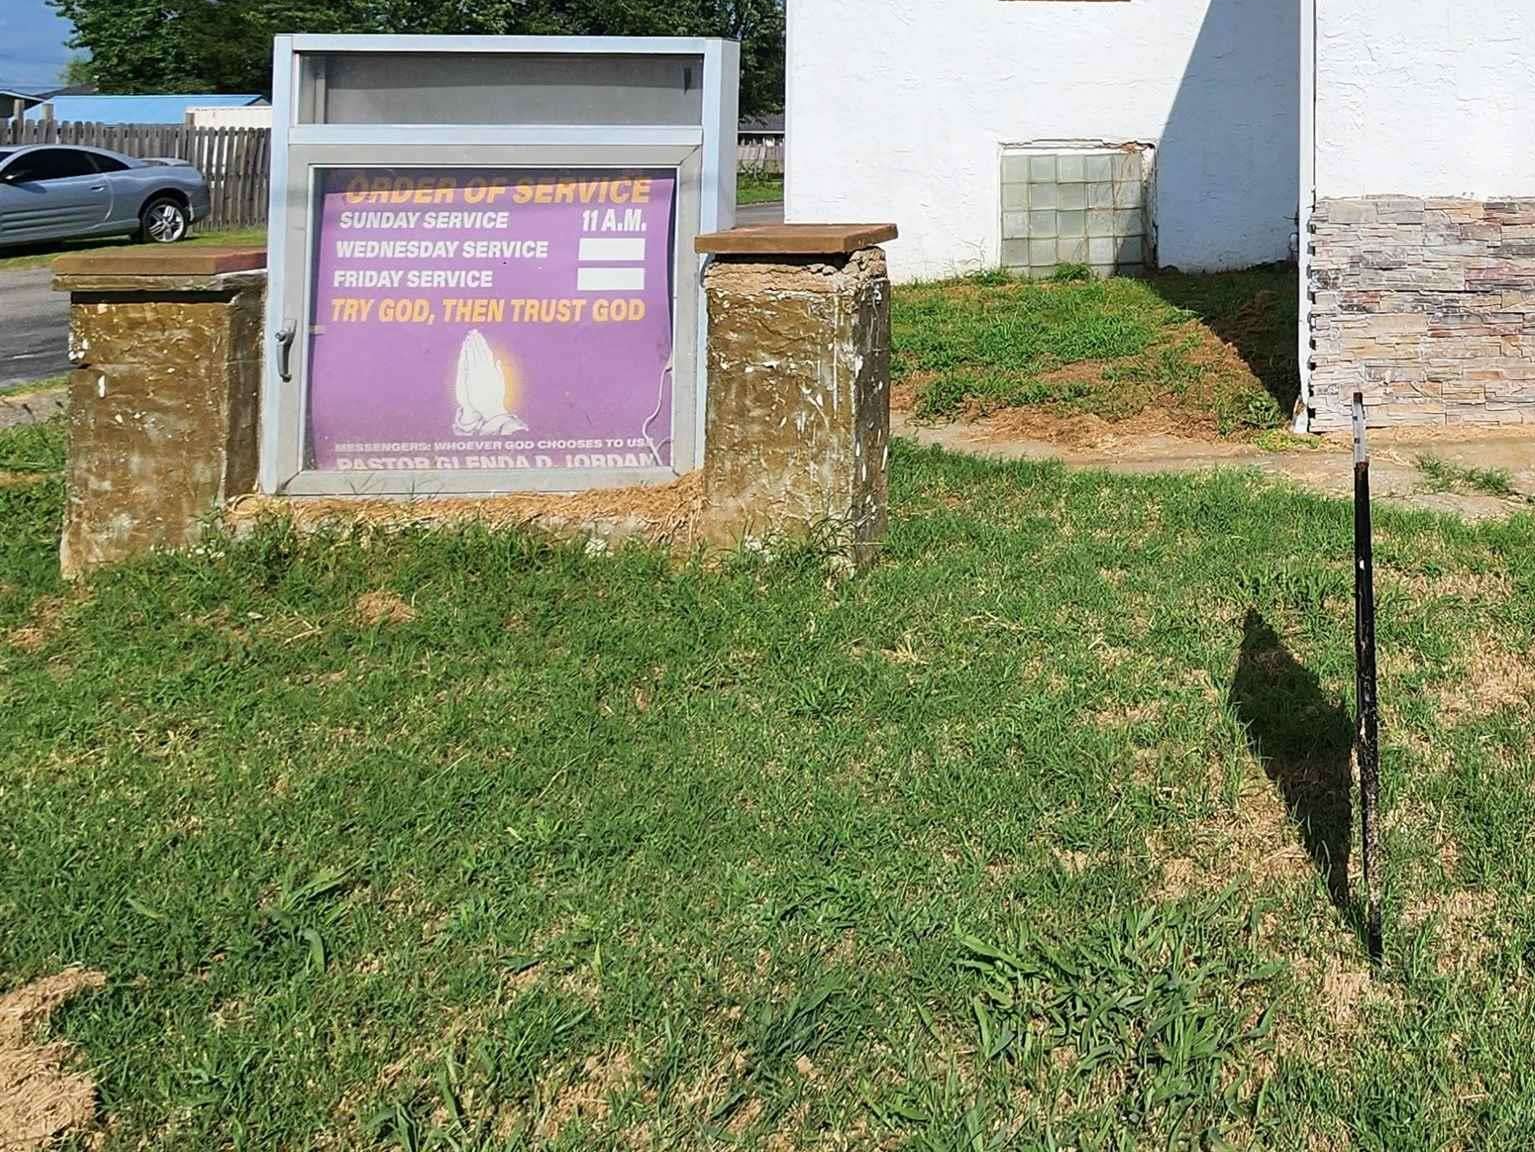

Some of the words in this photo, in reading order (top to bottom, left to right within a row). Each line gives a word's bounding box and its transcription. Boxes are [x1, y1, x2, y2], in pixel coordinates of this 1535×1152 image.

[344, 176, 457, 204] ORDER
[462, 175, 506, 204] OF
[511, 175, 651, 204] SERVICE
[339, 211, 421, 229] SUNDAY
[423, 211, 510, 229] SERVICE
[582, 209, 599, 232] 11
[600, 208, 648, 232] A.M.
[336, 240, 460, 258] WEDNESDAY
[462, 240, 549, 259] SERVICE
[333, 270, 403, 288] FRIDAY
[406, 270, 493, 288] SERVICE
[331, 298, 375, 322] TRY
[378, 298, 436, 326] GOD,
[442, 298, 505, 322] THEN
[510, 298, 587, 322] TRUST
[592, 298, 646, 322] GOD
[434, 440, 502, 452] WHOEVER
[504, 439, 535, 450] GOD
[537, 438, 602, 449] CHOOSES
[606, 438, 624, 448] TO
[535, 454, 560, 469] D
